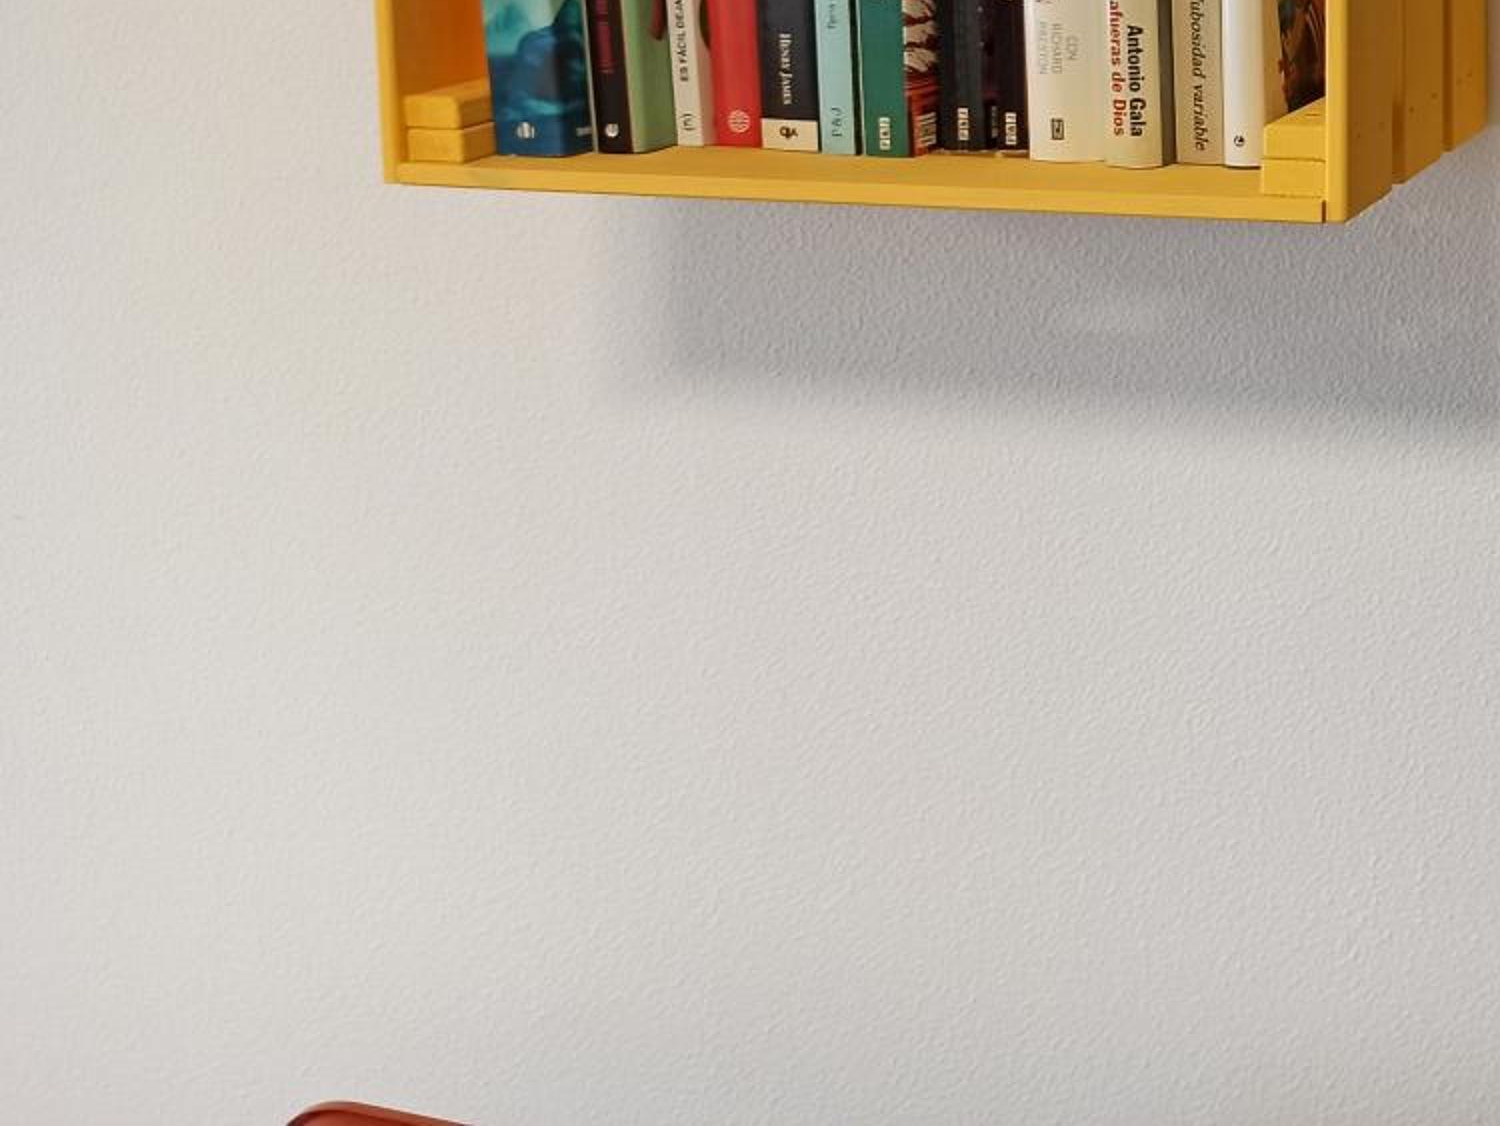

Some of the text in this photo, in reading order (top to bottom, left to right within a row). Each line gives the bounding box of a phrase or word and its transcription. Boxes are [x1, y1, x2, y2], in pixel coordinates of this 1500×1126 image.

[675, 30, 688, 65] FÁCIL
[1050, 22, 1064, 75] RICHARD
[1065, 35, 1079, 62] CON
[1109, 0, 1126, 65] afueras
[679, 67, 690, 83] ES
[1111, 71, 1126, 92] de
[1125, 24, 1147, 138] Antonio Gala
[1112, 99, 1127, 137] Dios
[1191, 84, 1210, 152] variable
